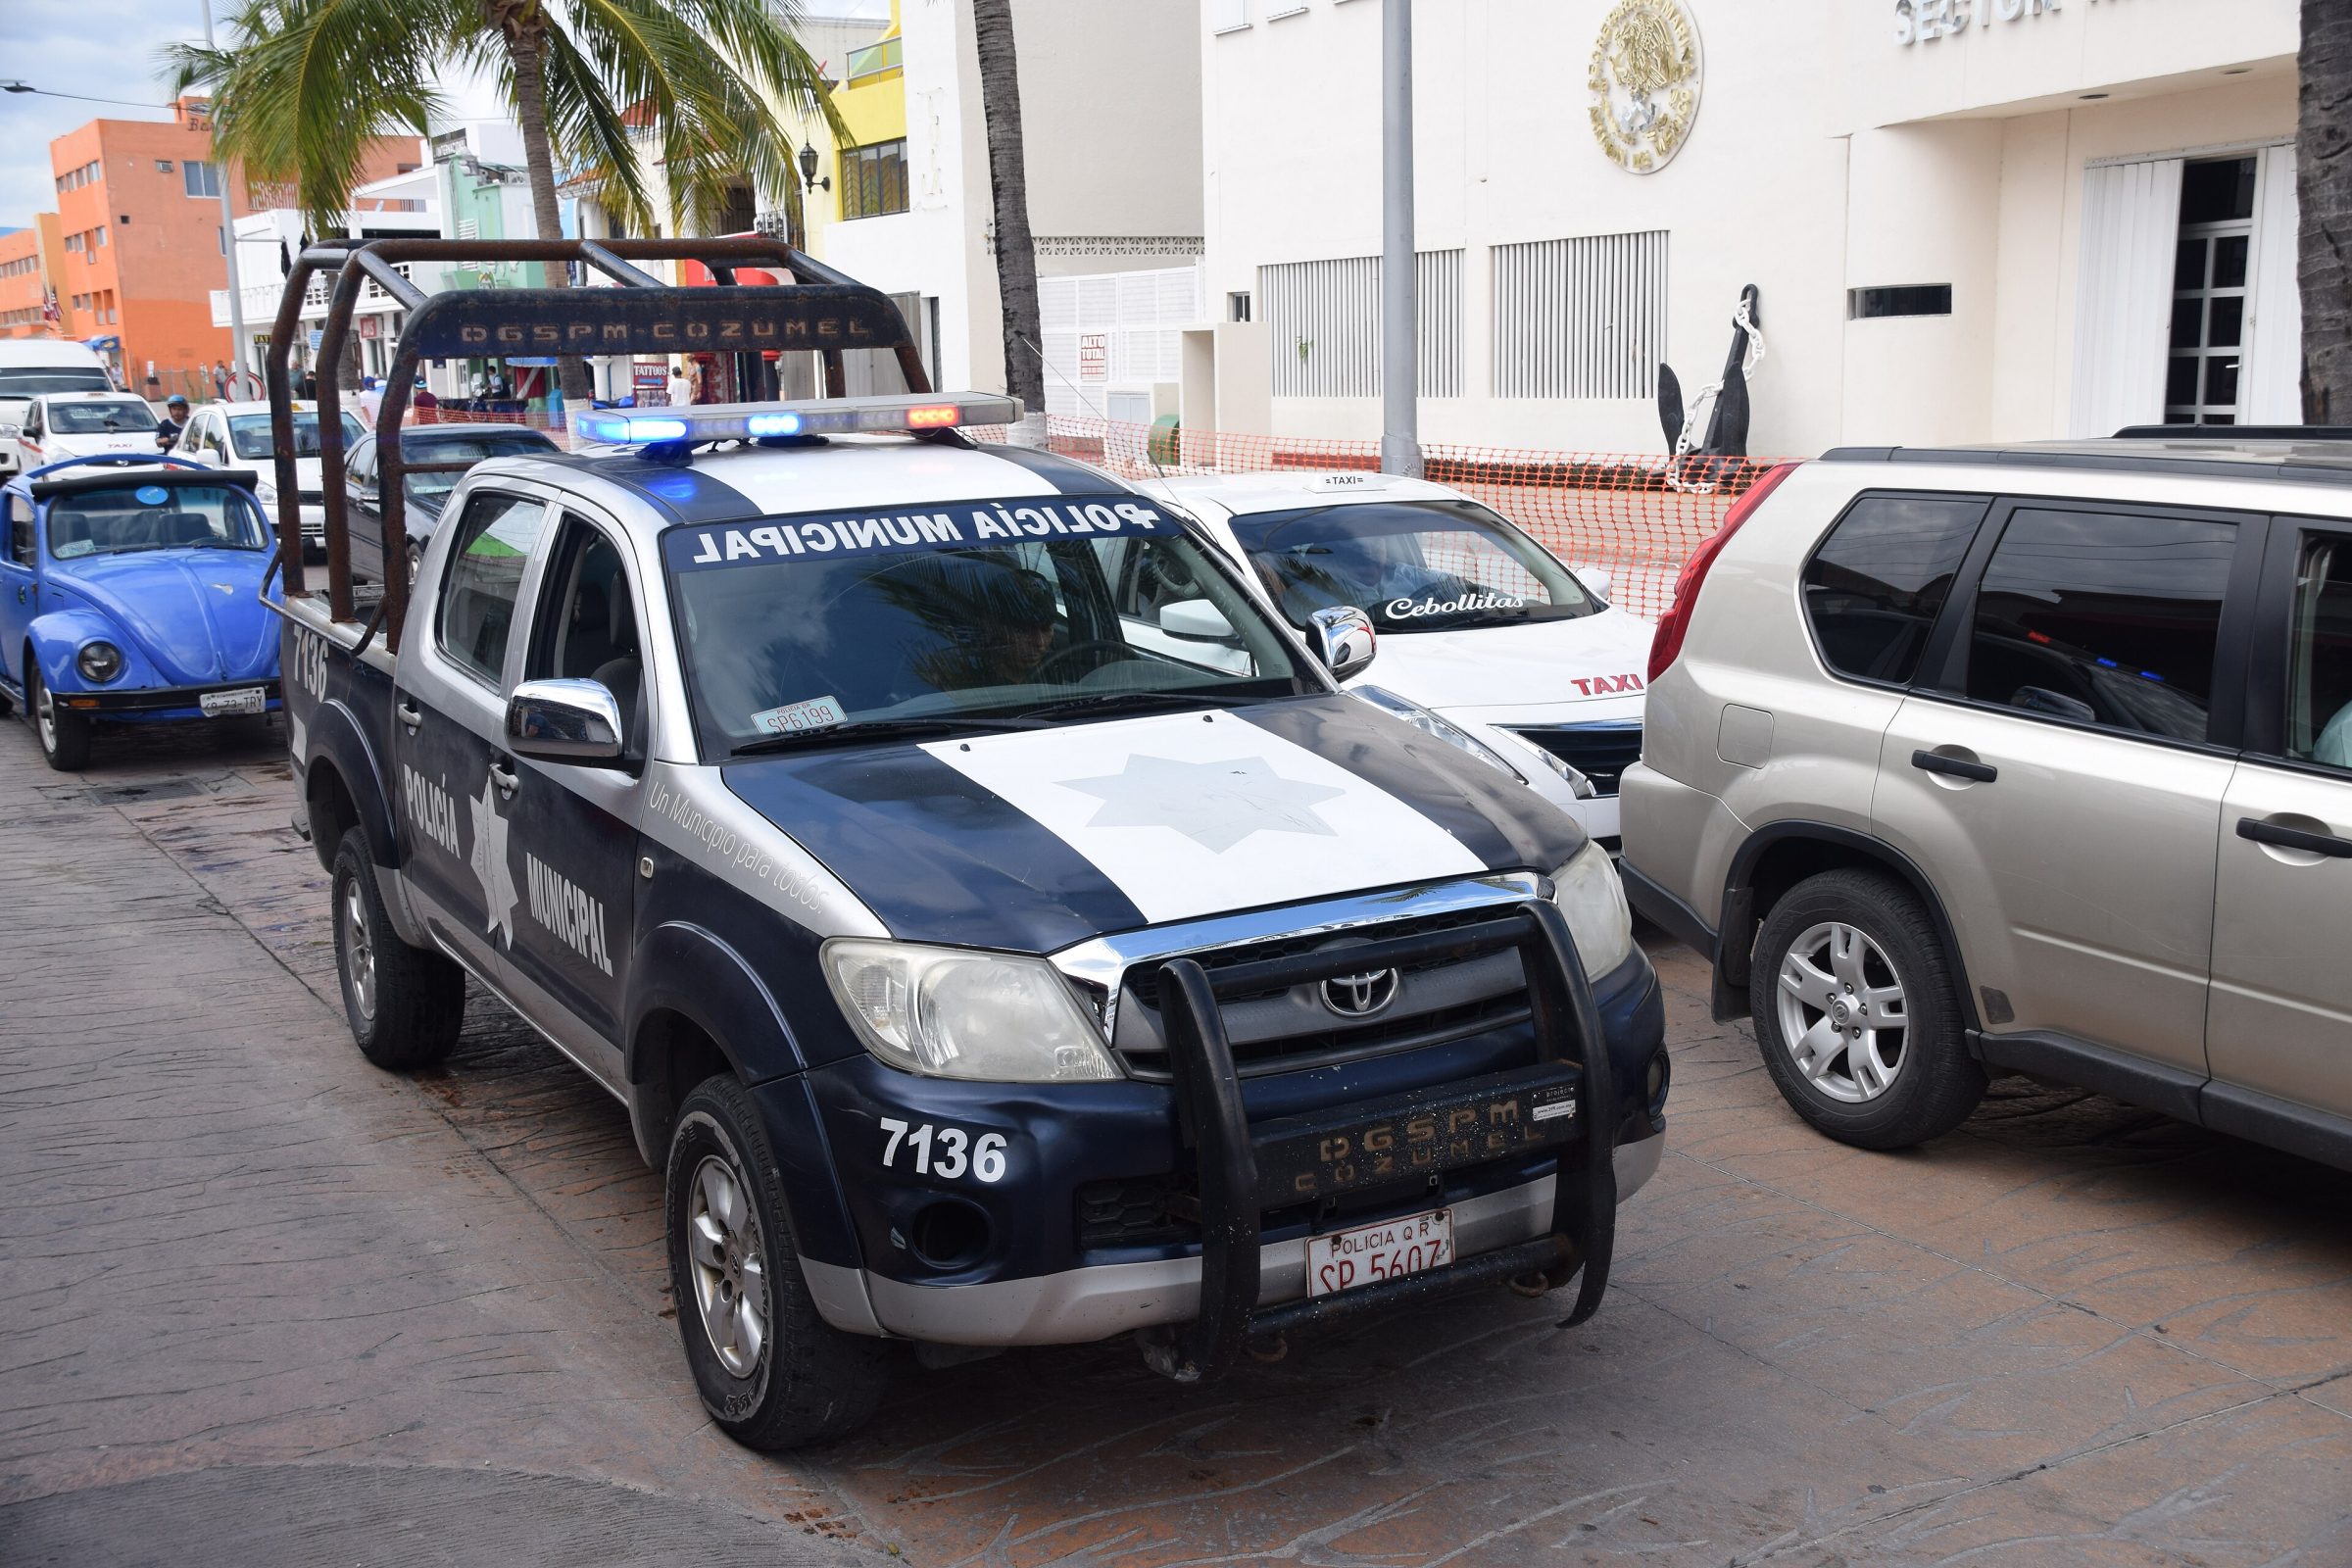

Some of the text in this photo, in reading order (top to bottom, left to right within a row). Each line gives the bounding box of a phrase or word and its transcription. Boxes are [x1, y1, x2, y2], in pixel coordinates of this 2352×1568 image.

[1081, 335, 1105, 348] ALTO
[1081, 348, 1105, 361] TOTAL
[633, 366, 667, 376] TATTOOS
[1385, 592, 1524, 620] Cebollitas
[294, 623, 329, 704] 7136
[1570, 673, 1645, 697] TAXI
[767, 706, 834, 733] SP6199
[776, 705, 801, 714] POLICIA
[404, 762, 462, 860] POLICÍA
[650, 781, 669, 814] Un
[668, 793, 737, 856] Municipio
[731, 841, 775, 879] para
[526, 852, 613, 978] MUNICIPAL
[1319, 1099, 1519, 1162] DGSPM
[880, 1116, 1007, 1183] 7136
[1330, 1230, 1396, 1258] POLICIA
